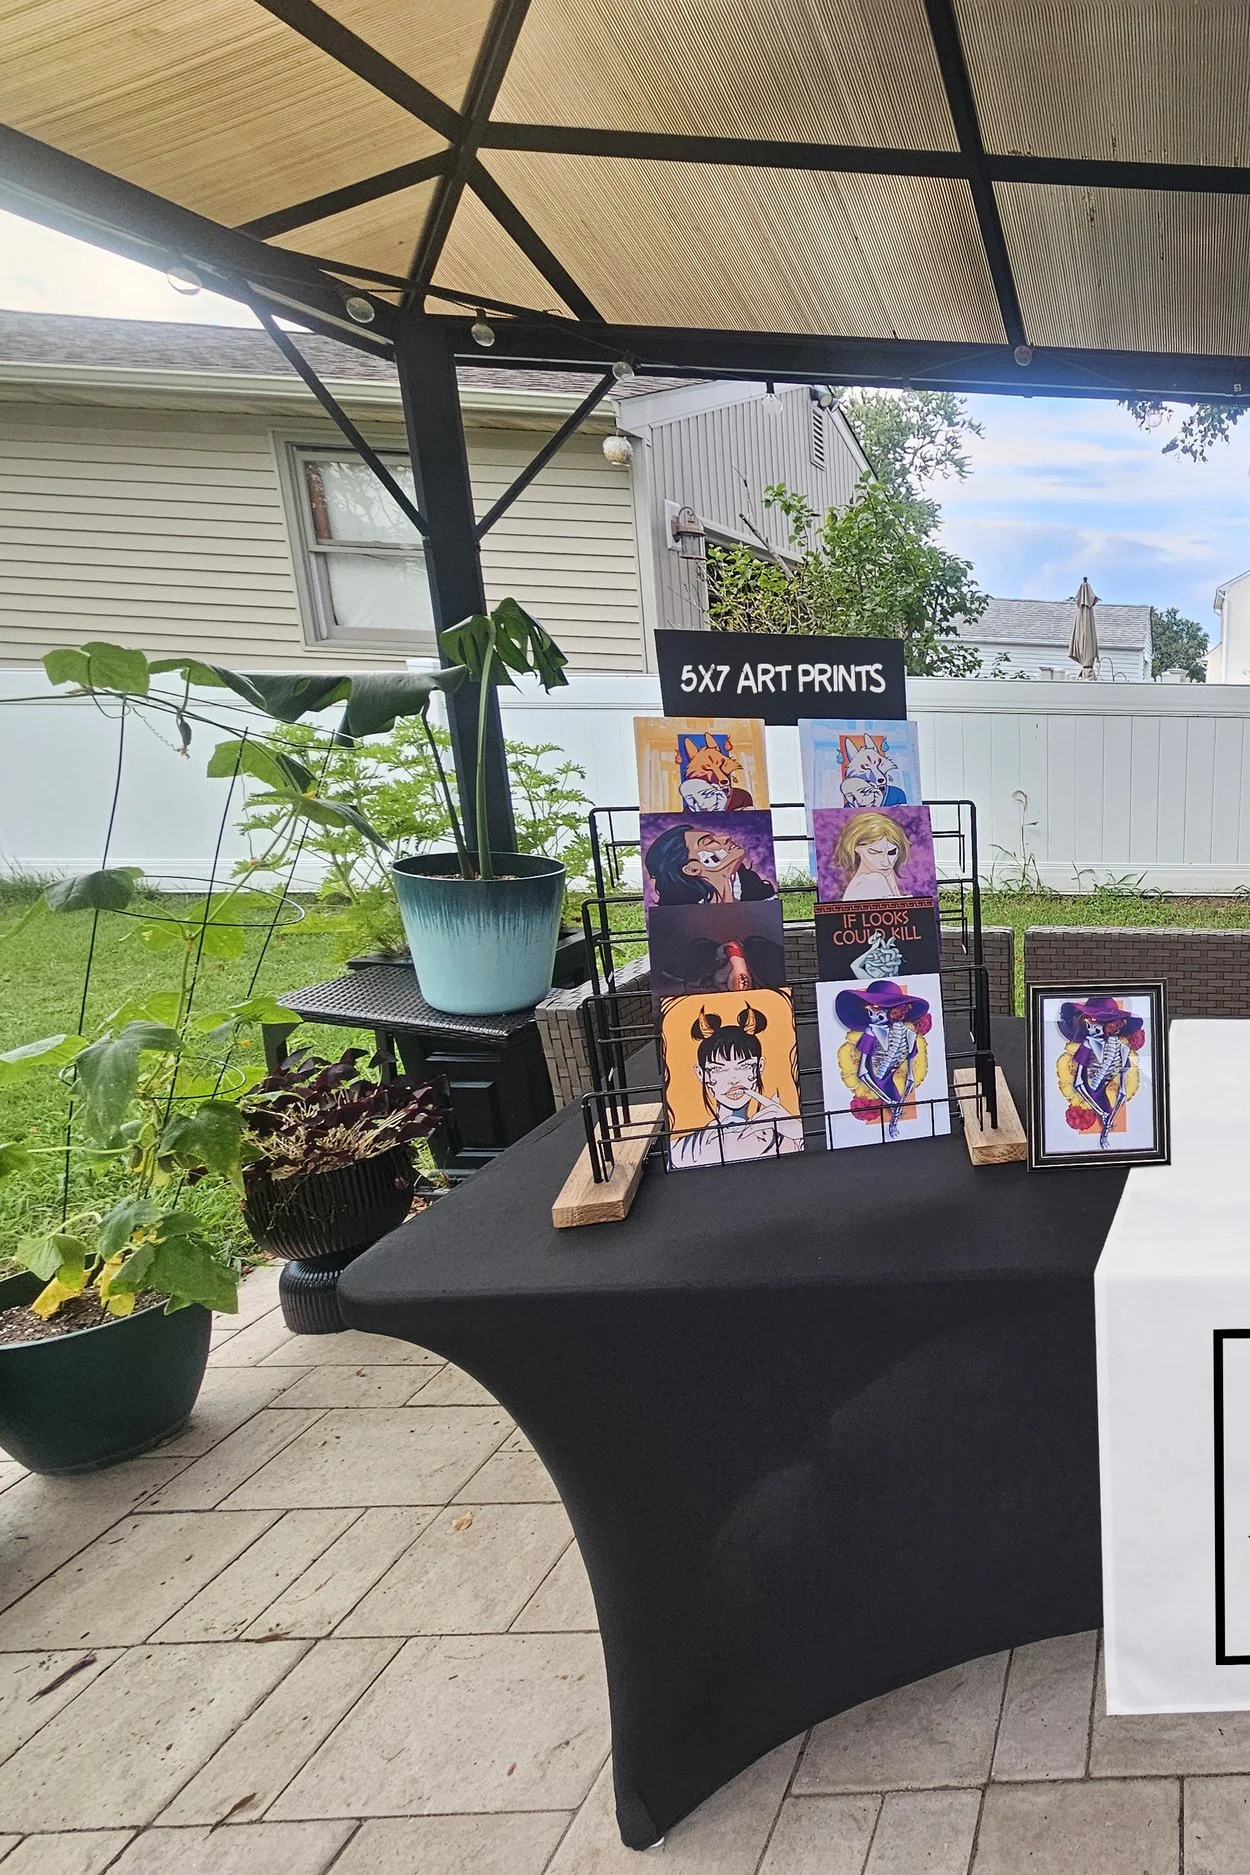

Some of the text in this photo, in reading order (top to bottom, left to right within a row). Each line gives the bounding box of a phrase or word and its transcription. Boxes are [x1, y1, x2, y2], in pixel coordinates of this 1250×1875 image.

[680, 662, 887, 695] 5X7 ART PRINTS
[843, 910, 909, 928] IF LOOKS
[891, 925, 922, 941] KILL
